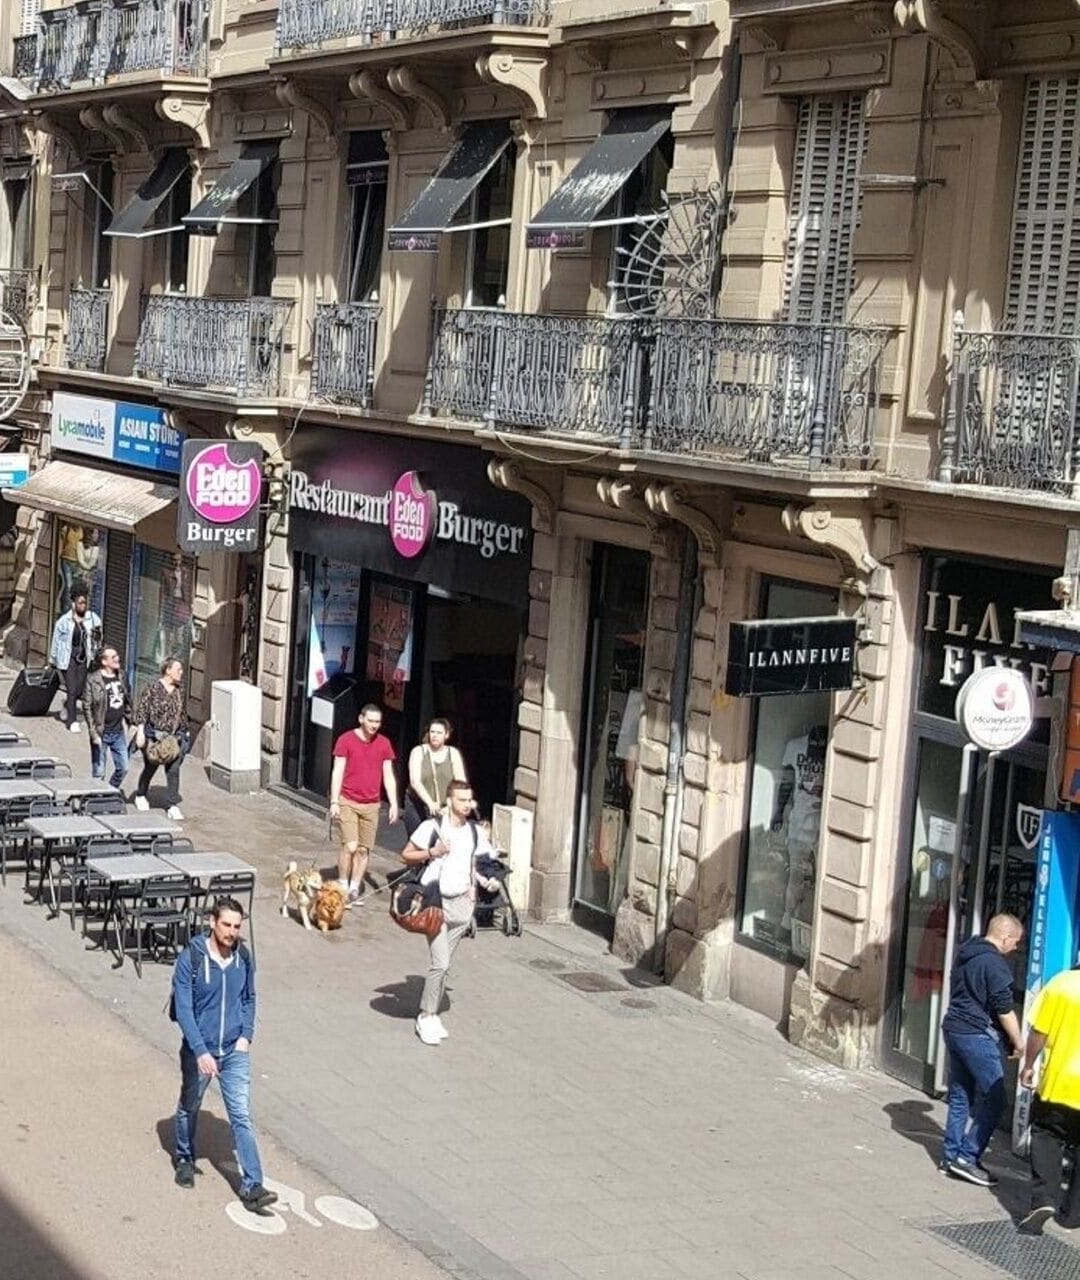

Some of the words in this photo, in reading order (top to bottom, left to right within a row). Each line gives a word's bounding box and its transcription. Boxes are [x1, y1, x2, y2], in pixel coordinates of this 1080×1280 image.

[58, 411, 105, 440] Lycamobile
[119, 417, 149, 440] ASIAN
[149, 422, 180, 447] STORE
[196, 462, 251, 492] Eden
[196, 490, 251, 507] FOOD
[289, 470, 392, 526] Restaurant
[394, 491, 424, 522] Eden
[187, 522, 256, 547] Burger
[393, 522, 424, 542] FOOD
[437, 501, 524, 558] Burger
[749, 646, 851, 668] ILANNFIVE
